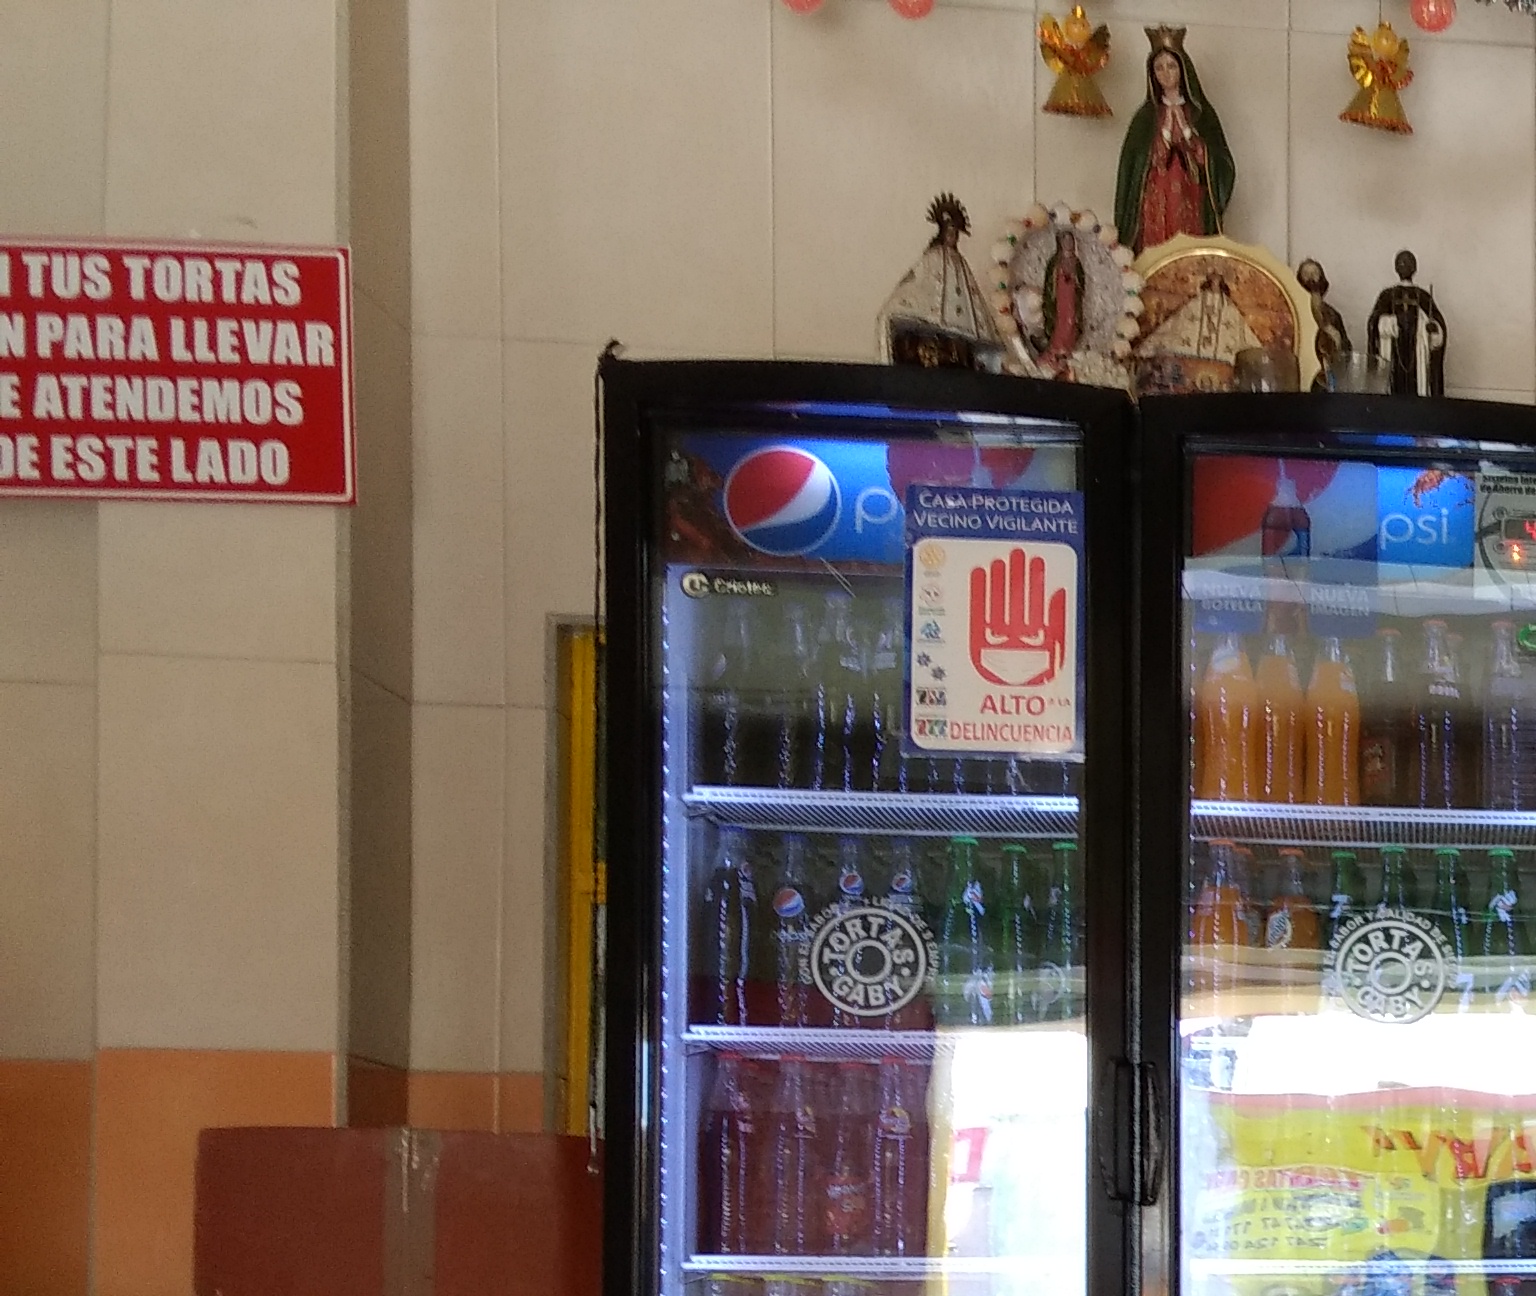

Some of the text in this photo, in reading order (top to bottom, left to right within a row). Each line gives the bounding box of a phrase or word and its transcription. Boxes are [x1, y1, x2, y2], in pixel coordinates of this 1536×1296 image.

[21, 252, 112, 300] TUS
[122, 254, 302, 307] TORTAS
[35, 313, 160, 363] PARA
[169, 315, 336, 367] LLEVAR
[33, 373, 304, 426] ATENDEMOS
[50, 433, 160, 482] ESTE
[170, 436, 291, 486] LADO
[913, 509, 1078, 534] VECINO VIGILANTE
[919, 489, 1074, 515] CASA PROTEGIDA
[980, 694, 1046, 716] ALTO
[950, 721, 1073, 743] DELINCUENCIA
[822, 917, 915, 965] TORTAS
[1346, 928, 1433, 977] TORTAS
[832, 976, 905, 1007] GABY
